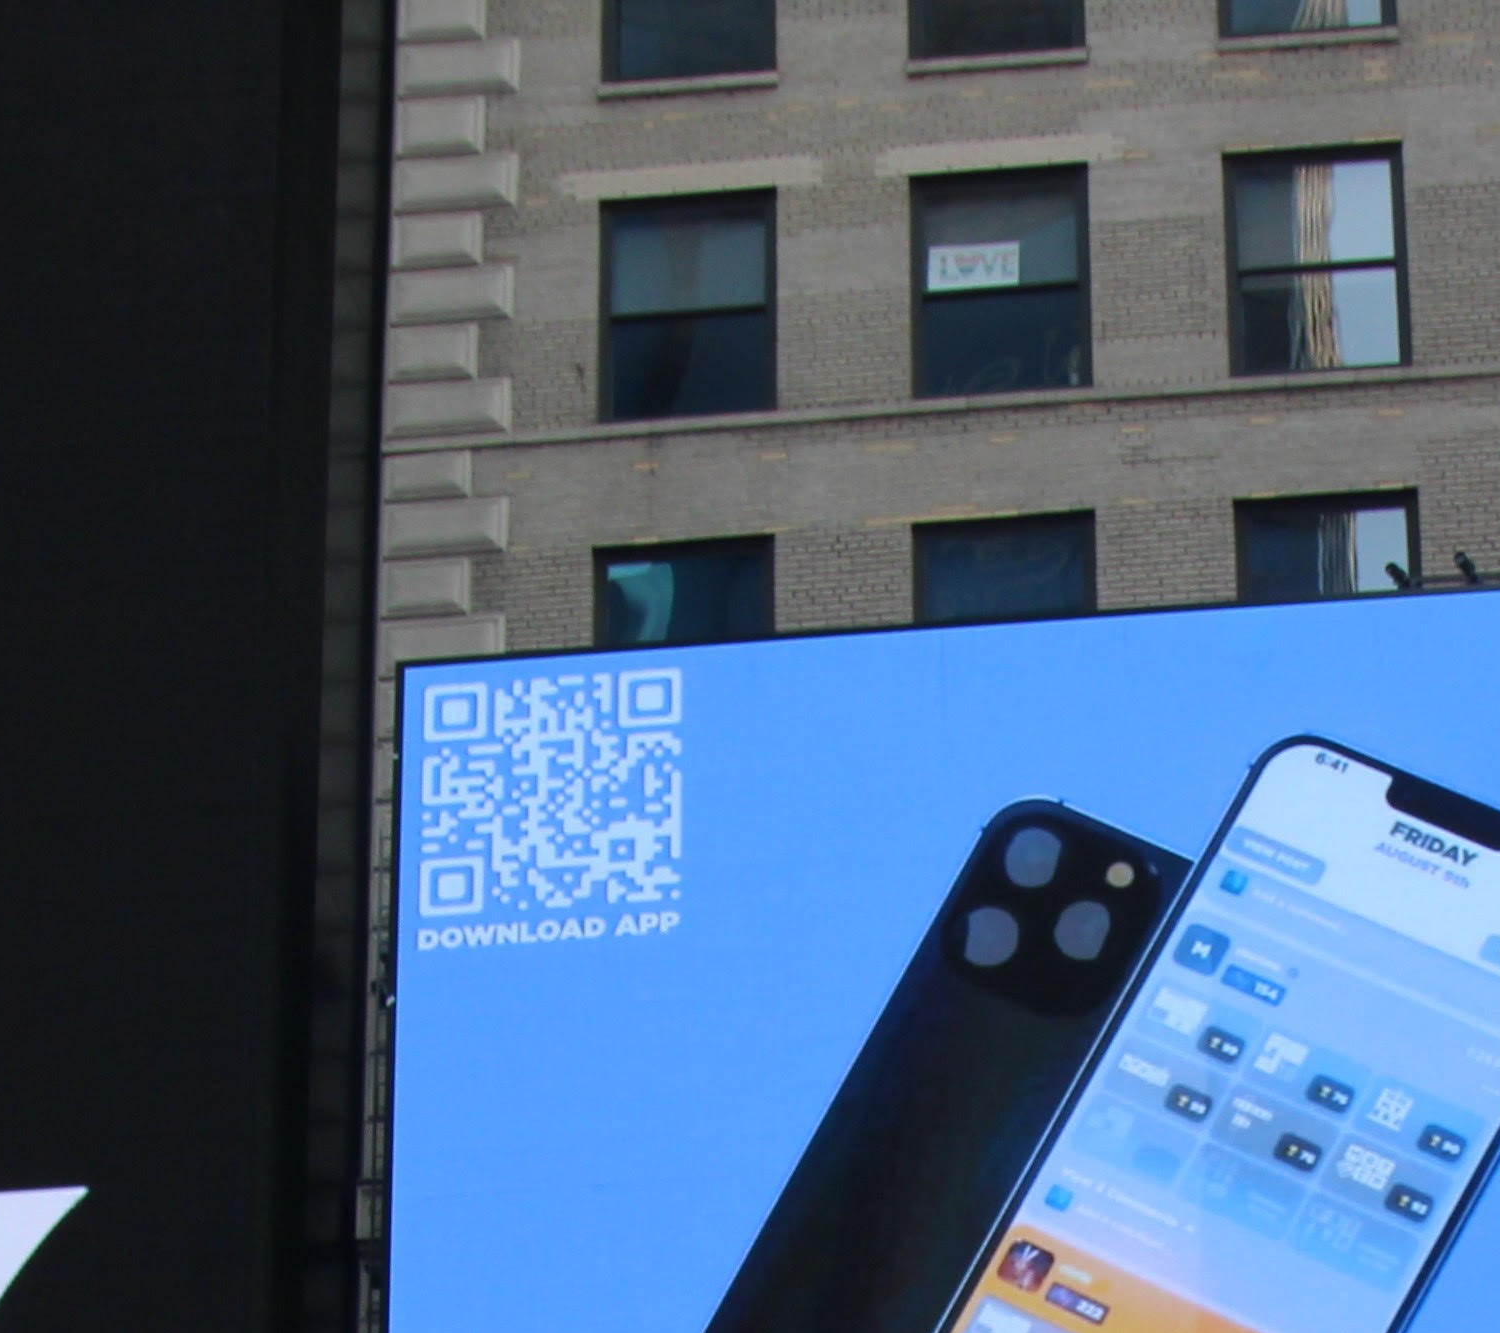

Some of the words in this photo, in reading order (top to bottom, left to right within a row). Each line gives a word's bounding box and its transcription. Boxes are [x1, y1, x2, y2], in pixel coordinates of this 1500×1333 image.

[1374, 842, 1442, 877] AUGUST
[1389, 820, 1479, 868] FRIDAY
[416, 917, 606, 951] DOWNLOAD
[615, 912, 680, 937] APP
